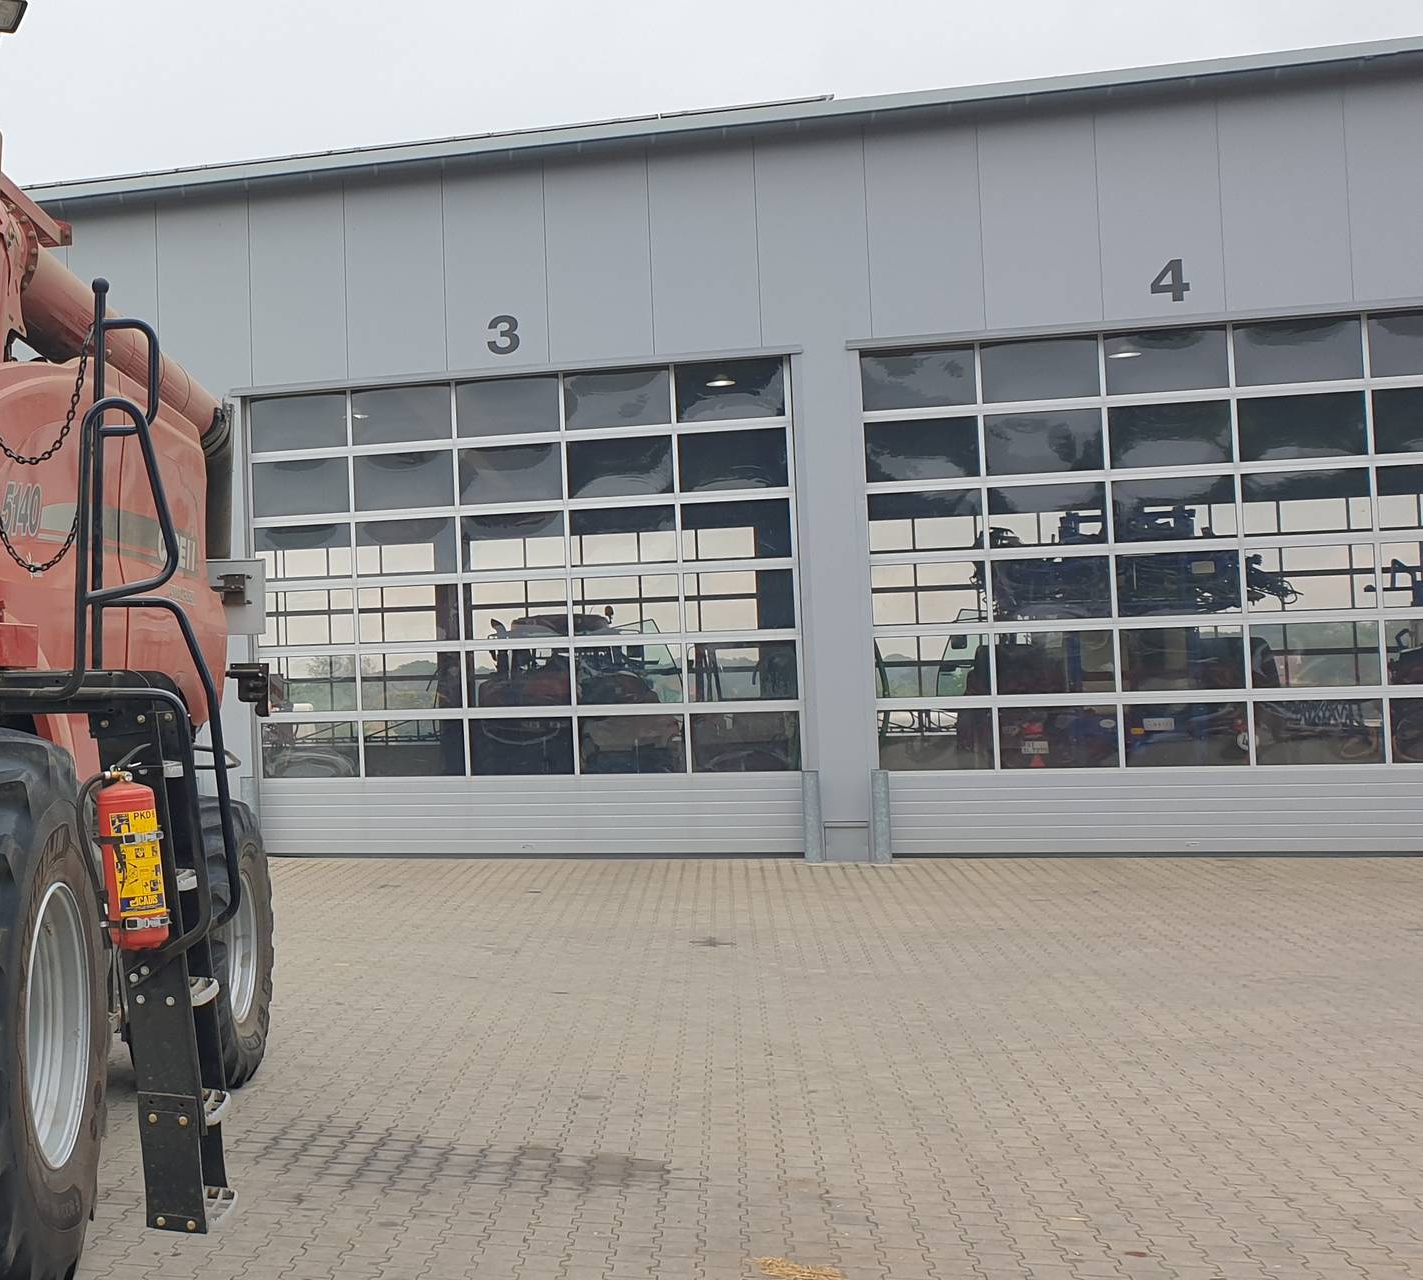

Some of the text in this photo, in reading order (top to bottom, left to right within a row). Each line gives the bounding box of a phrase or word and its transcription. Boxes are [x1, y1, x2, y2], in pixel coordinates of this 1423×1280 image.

[1150, 258, 1190, 302] 4
[487, 314, 520, 355] 3
[2, 480, 42, 537] 5140
